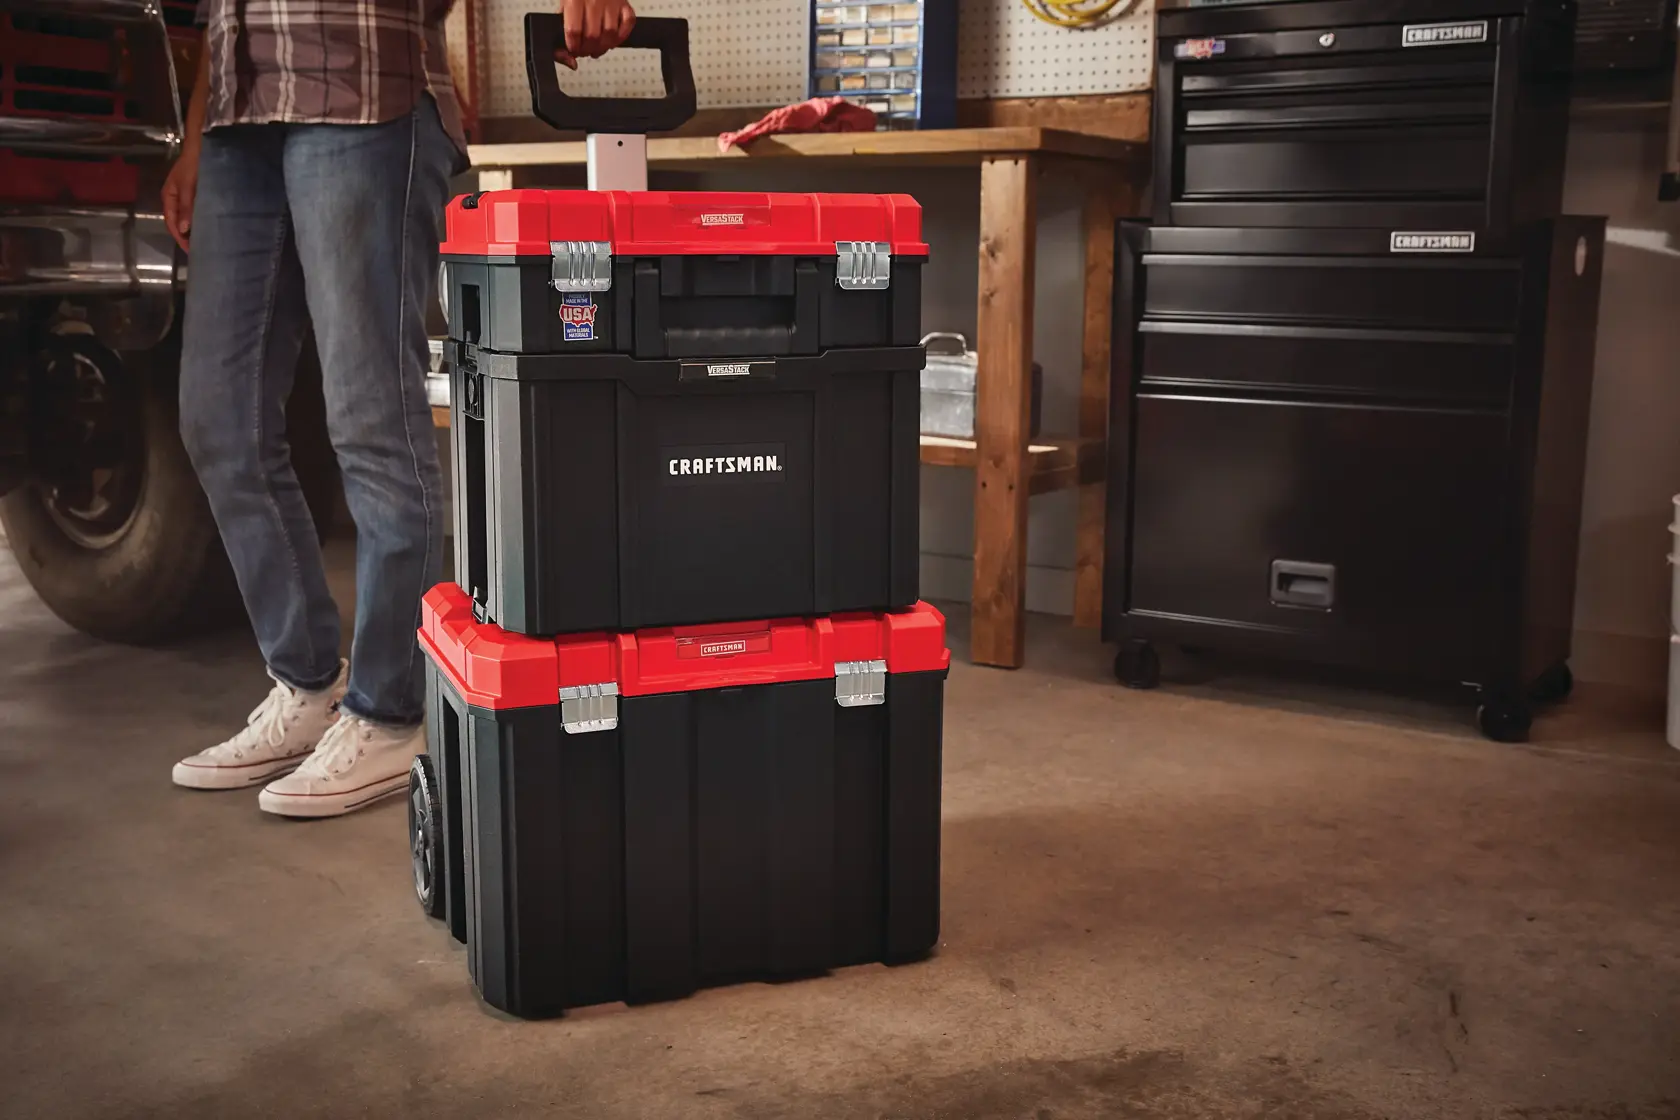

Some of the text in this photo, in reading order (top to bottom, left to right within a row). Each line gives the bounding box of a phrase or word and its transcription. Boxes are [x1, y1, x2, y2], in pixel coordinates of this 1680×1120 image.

[1407, 25, 1482, 42] CRAFTSMAN
[701, 213, 744, 224] VERSASTACK
[1395, 235, 1470, 248] CRAFTSMAN
[563, 307, 593, 321] USA
[707, 364, 750, 375] VERSASTACK
[703, 643, 743, 654] CRAFTSMAN
